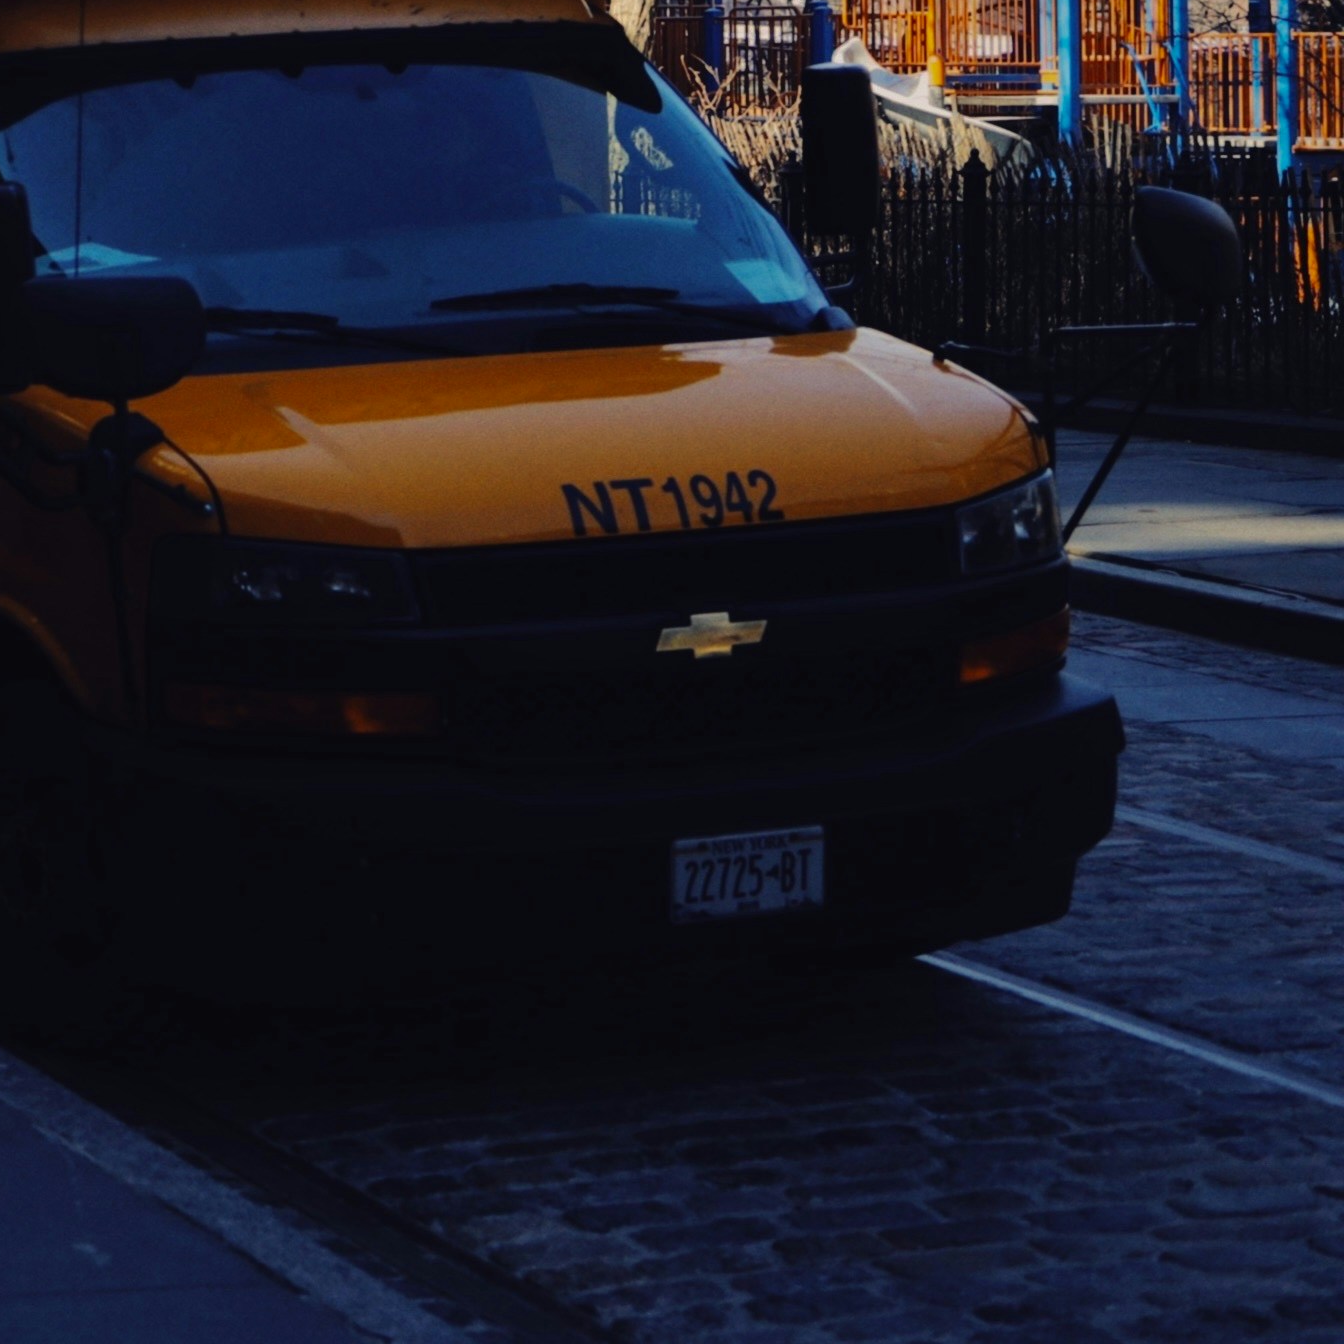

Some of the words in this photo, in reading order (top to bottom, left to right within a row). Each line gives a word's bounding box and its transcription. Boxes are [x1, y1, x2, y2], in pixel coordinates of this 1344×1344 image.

[562, 469, 786, 537] NT1942
[711, 838, 746, 856] NEW
[749, 833, 788, 851] YORK
